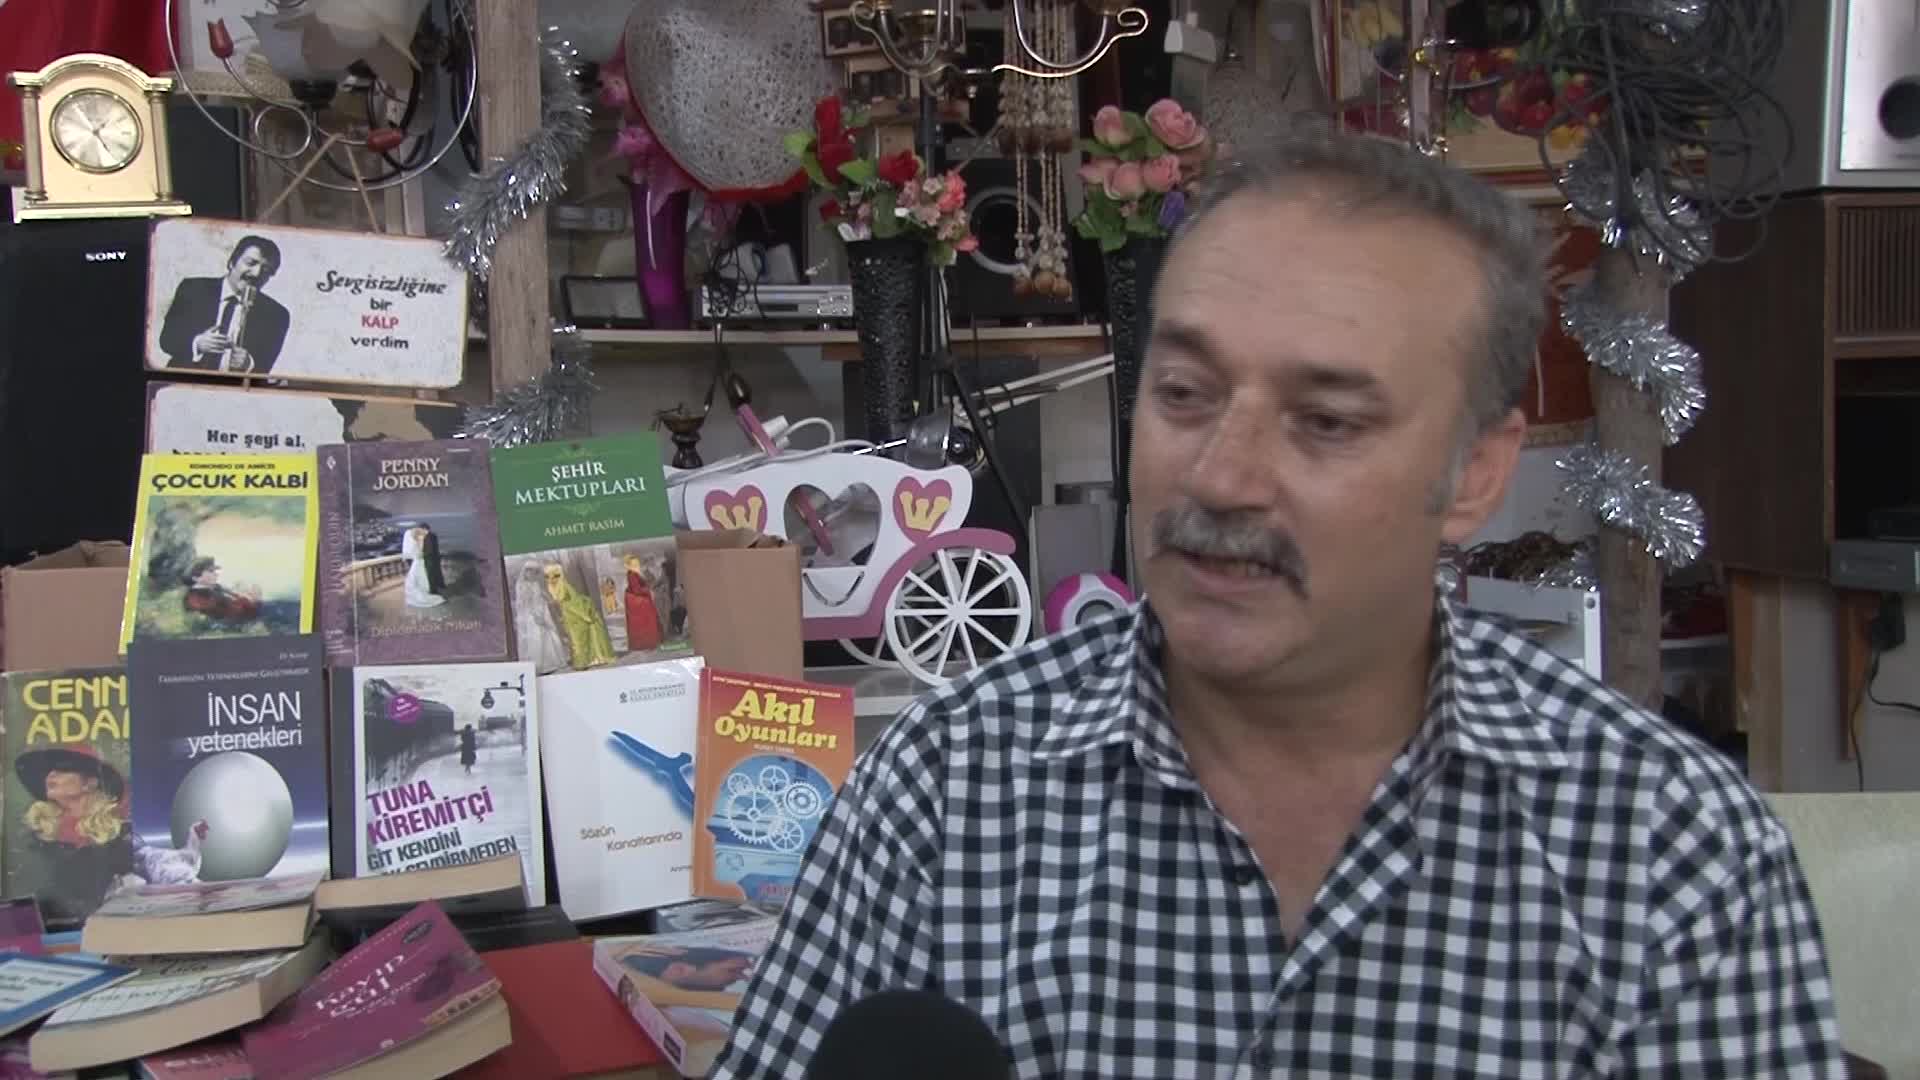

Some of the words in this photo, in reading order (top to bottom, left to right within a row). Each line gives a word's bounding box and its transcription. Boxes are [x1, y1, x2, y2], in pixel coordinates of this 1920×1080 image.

[85, 250, 127, 261] SONY
[316, 269, 448, 298] Sevgisizliğine
[369, 297, 393, 311] bir
[361, 315, 399, 329] KALP
[350, 336, 409, 349] verdim
[207, 429, 239, 444] Her
[244, 433, 279, 449] şeyi
[381, 457, 440, 475] PENNY
[551, 460, 606, 483] ŞEHİR
[151, 473, 237, 492] ÇOCUK
[244, 471, 308, 489] KALBİ
[372, 472, 450, 491] JORDAN
[514, 476, 646, 505] MEKTUPLARI
[543, 521, 586, 537] AHMET
[23, 674, 128, 711] CENN
[207, 690, 302, 727] İNSAN
[730, 688, 817, 727] Akıl
[187, 722, 302, 759] yetenekleri
[714, 715, 838, 750] Oyunları
[366, 779, 436, 816] TUNA
[367, 785, 494, 845] KİREMİTÇİ
[580, 824, 616, 840] Sözün
[367, 848, 395, 871] GİT
[397, 826, 463, 862] KENDİNİ
